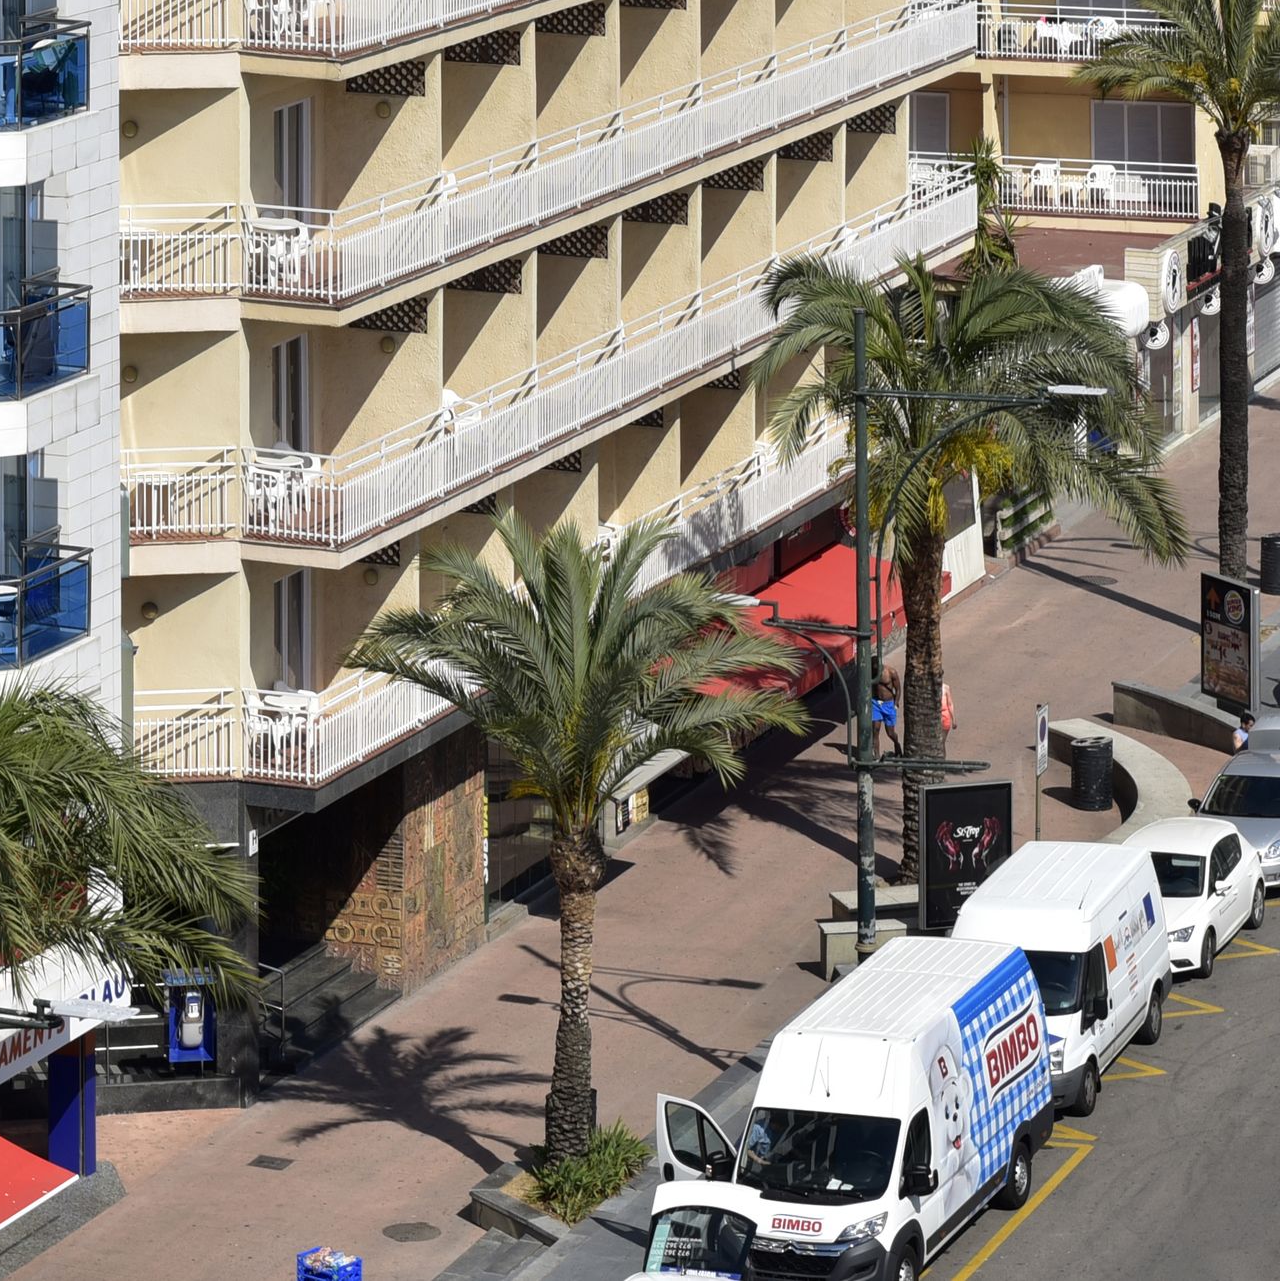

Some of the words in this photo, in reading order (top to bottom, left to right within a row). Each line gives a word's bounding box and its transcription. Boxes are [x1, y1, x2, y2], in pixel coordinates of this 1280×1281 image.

[986, 1013, 1039, 1088] BIMBO
[937, 1056, 949, 1079] B
[771, 1217, 823, 1233] BIMBO
